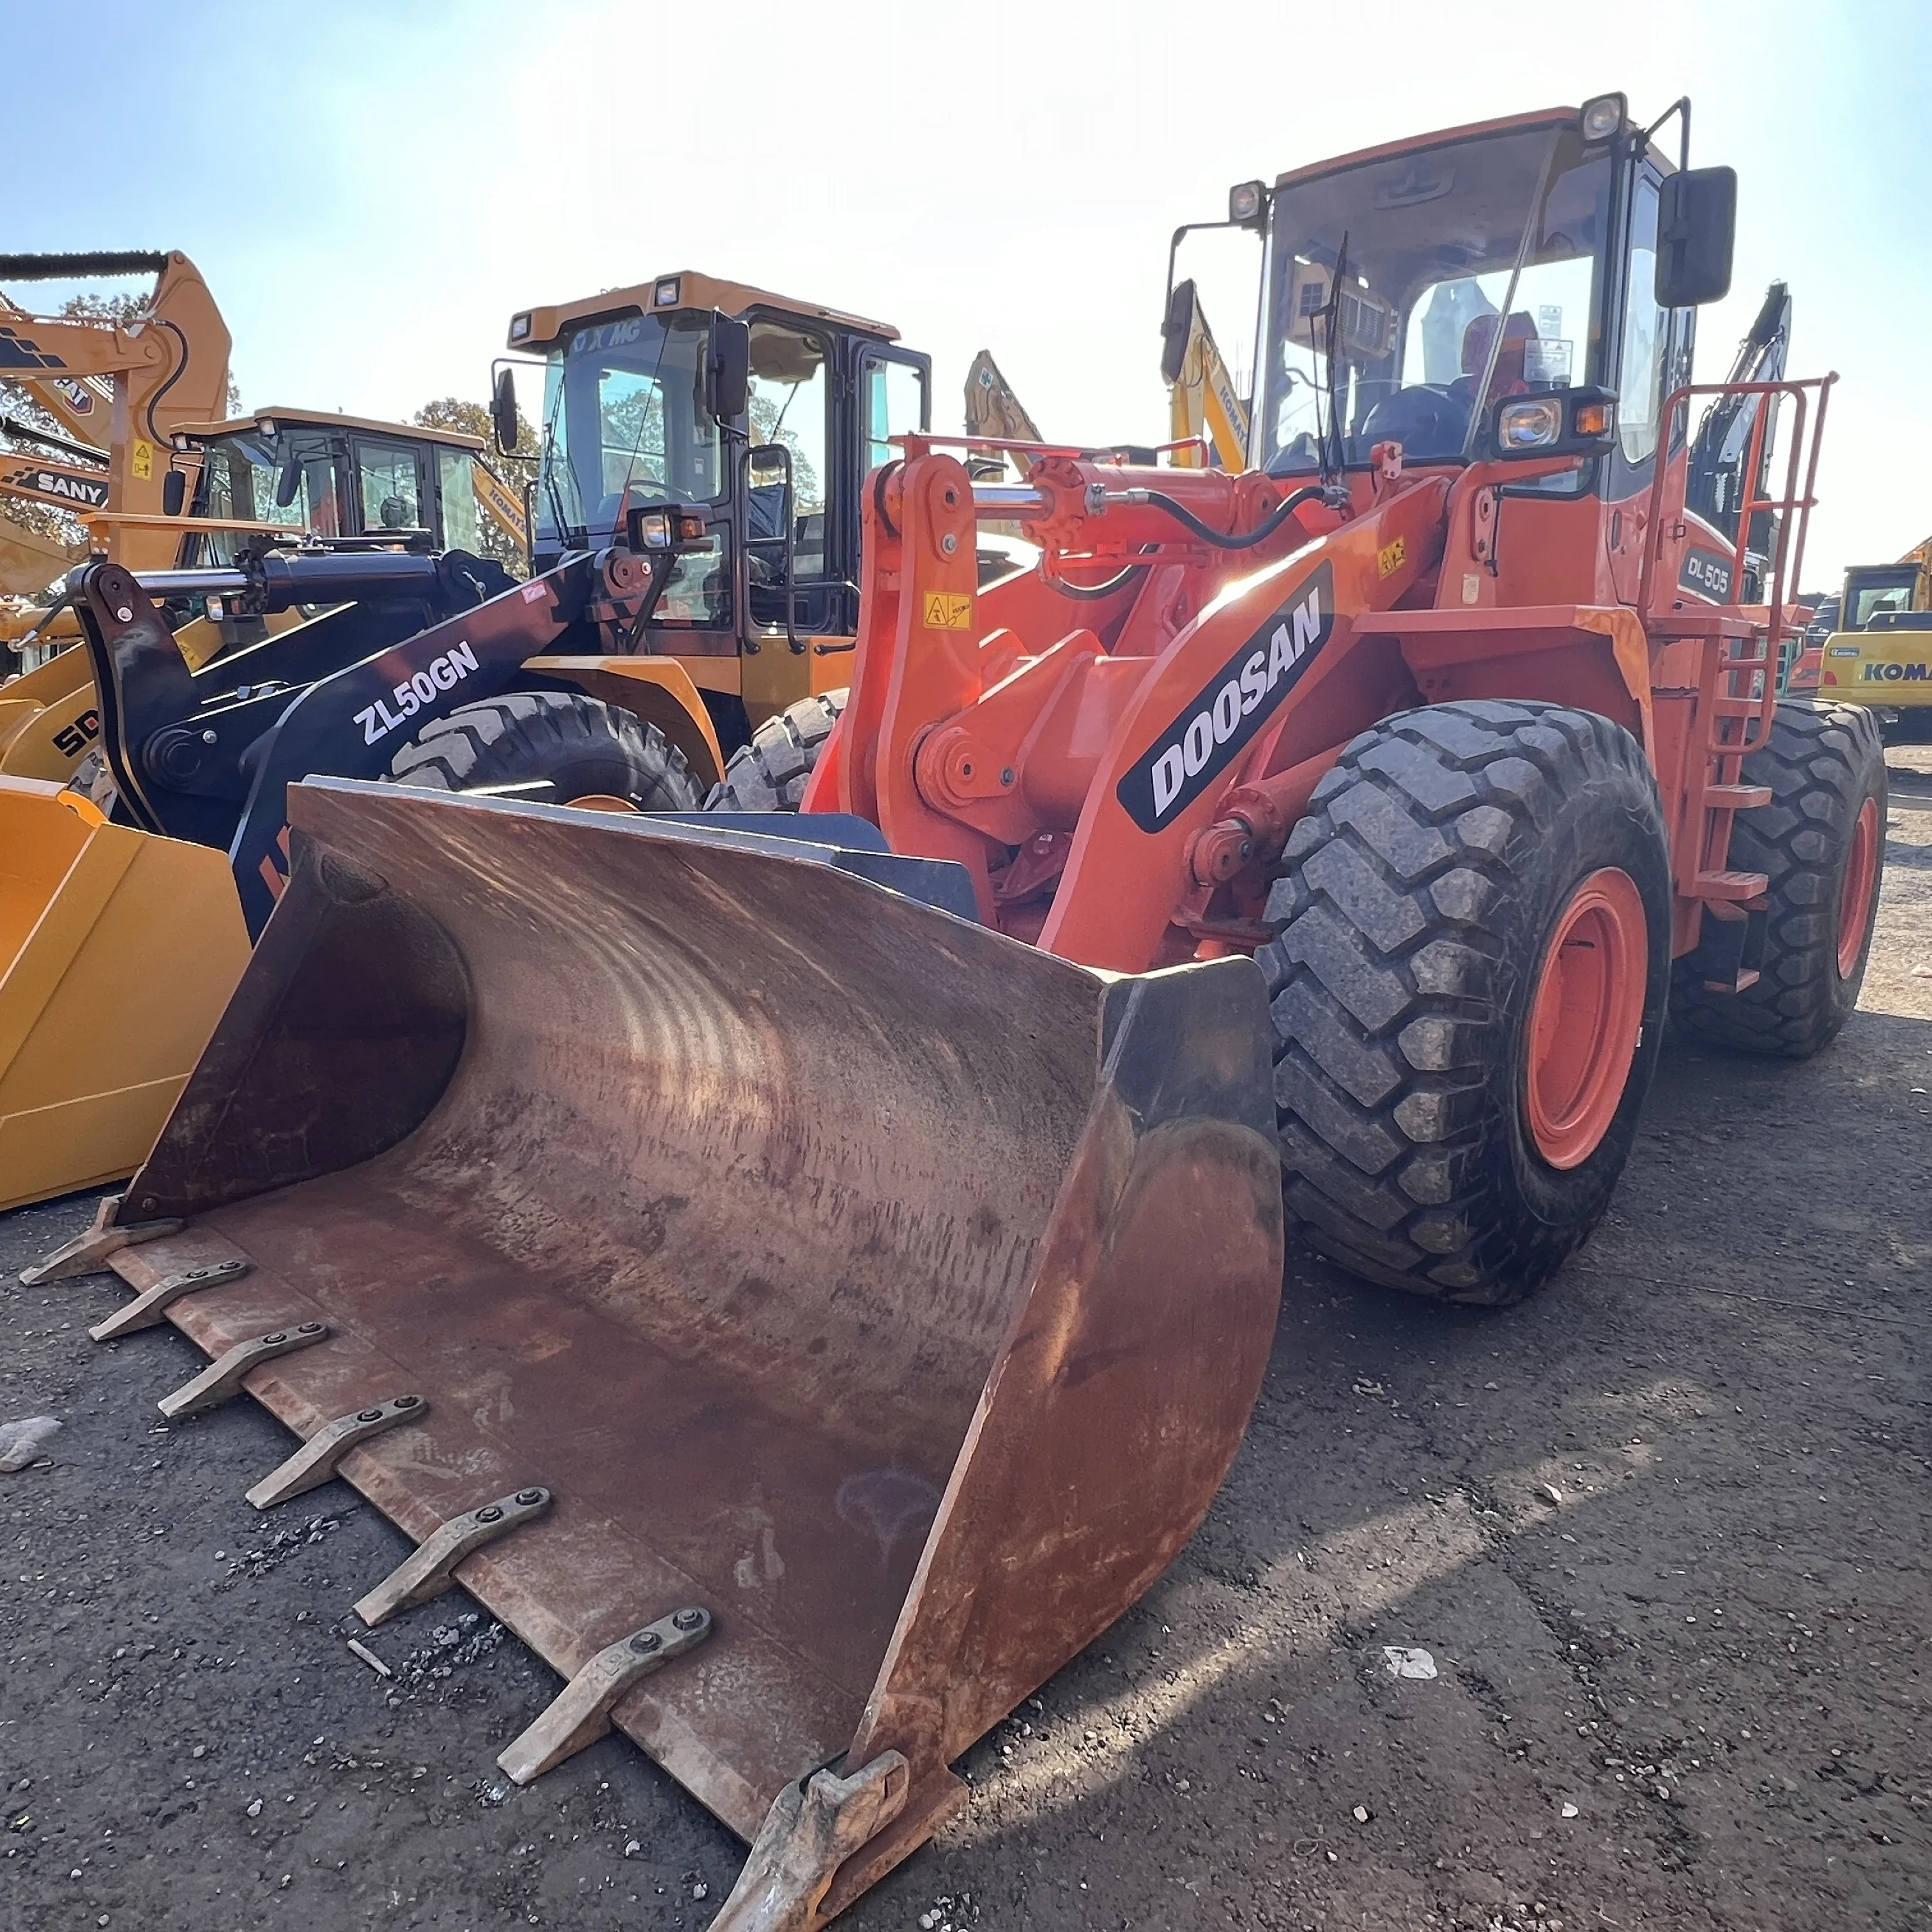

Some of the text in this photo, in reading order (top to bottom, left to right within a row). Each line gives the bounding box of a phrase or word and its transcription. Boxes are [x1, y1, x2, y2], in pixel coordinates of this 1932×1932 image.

[53, 379, 89, 405] CAT
[38, 473, 102, 503] SANY
[1688, 556, 1729, 594] DL505
[353, 640, 479, 746] ZL50GN
[1151, 586, 1321, 818] DOOSAN
